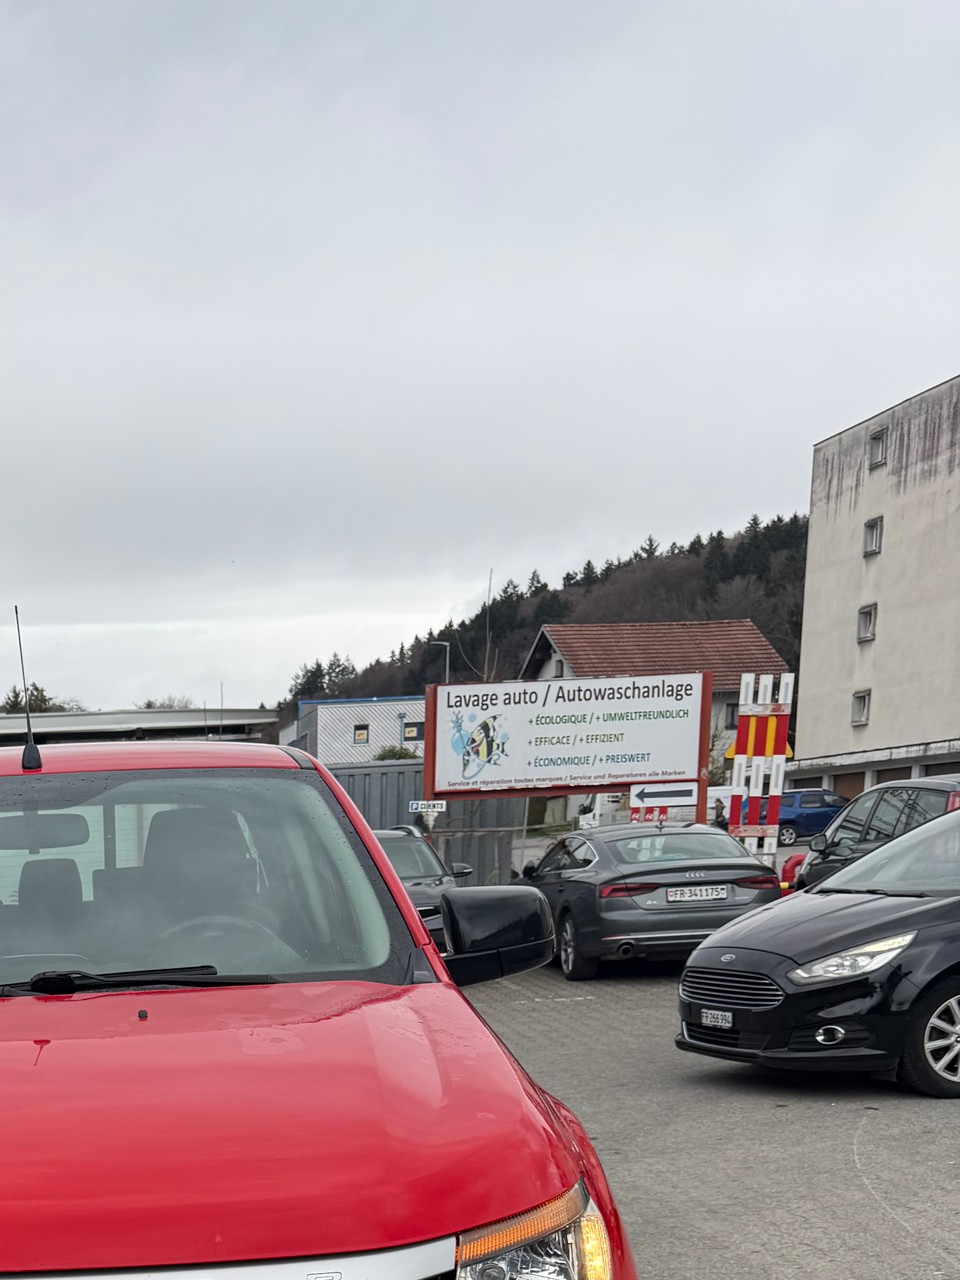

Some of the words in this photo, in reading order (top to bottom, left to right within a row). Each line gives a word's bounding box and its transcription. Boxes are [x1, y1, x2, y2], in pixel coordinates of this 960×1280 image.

[447, 691, 498, 711] Lavage
[503, 689, 538, 706] auto
[555, 679, 693, 703] Autowaschanlage
[535, 713, 587, 726] ÉCOLOGIQUE
[602, 709, 689, 722] UMWELTFREUNDLICH
[534, 735, 571, 746] EFFICACE
[585, 732, 625, 744] EFFIZIENT
[534, 756, 591, 768] ÉCONOMIQUE
[605, 752, 652, 764] PREISWERT
[535, 775, 563, 783] marques
[569, 773, 592, 781] Service
[661, 768, 686, 777] Marken
